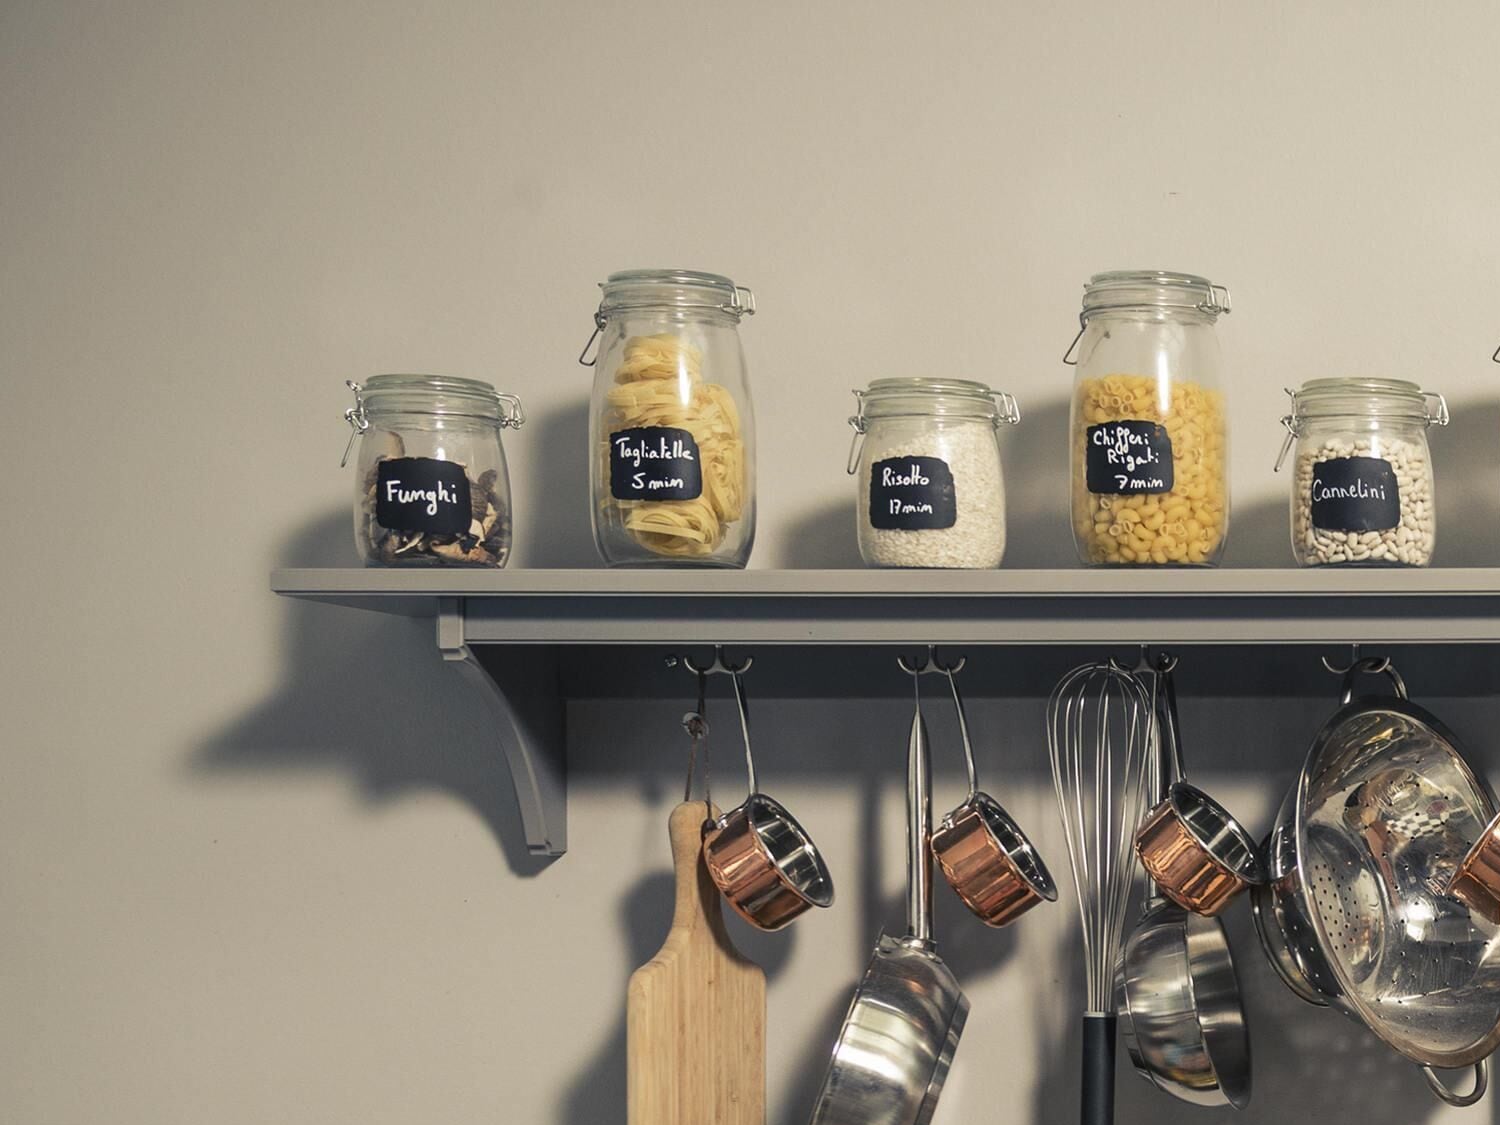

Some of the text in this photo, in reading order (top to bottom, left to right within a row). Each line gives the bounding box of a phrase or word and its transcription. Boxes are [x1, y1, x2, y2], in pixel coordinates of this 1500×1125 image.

[615, 437, 694, 467] Tagliatelle
[1107, 446, 1159, 472] Rigati
[631, 472, 684, 490] 5 min
[882, 464, 930, 486] Risotto
[1130, 477, 1164, 489] min
[386, 480, 457, 515] Funghi
[1312, 478, 1386, 502] Cannelini
